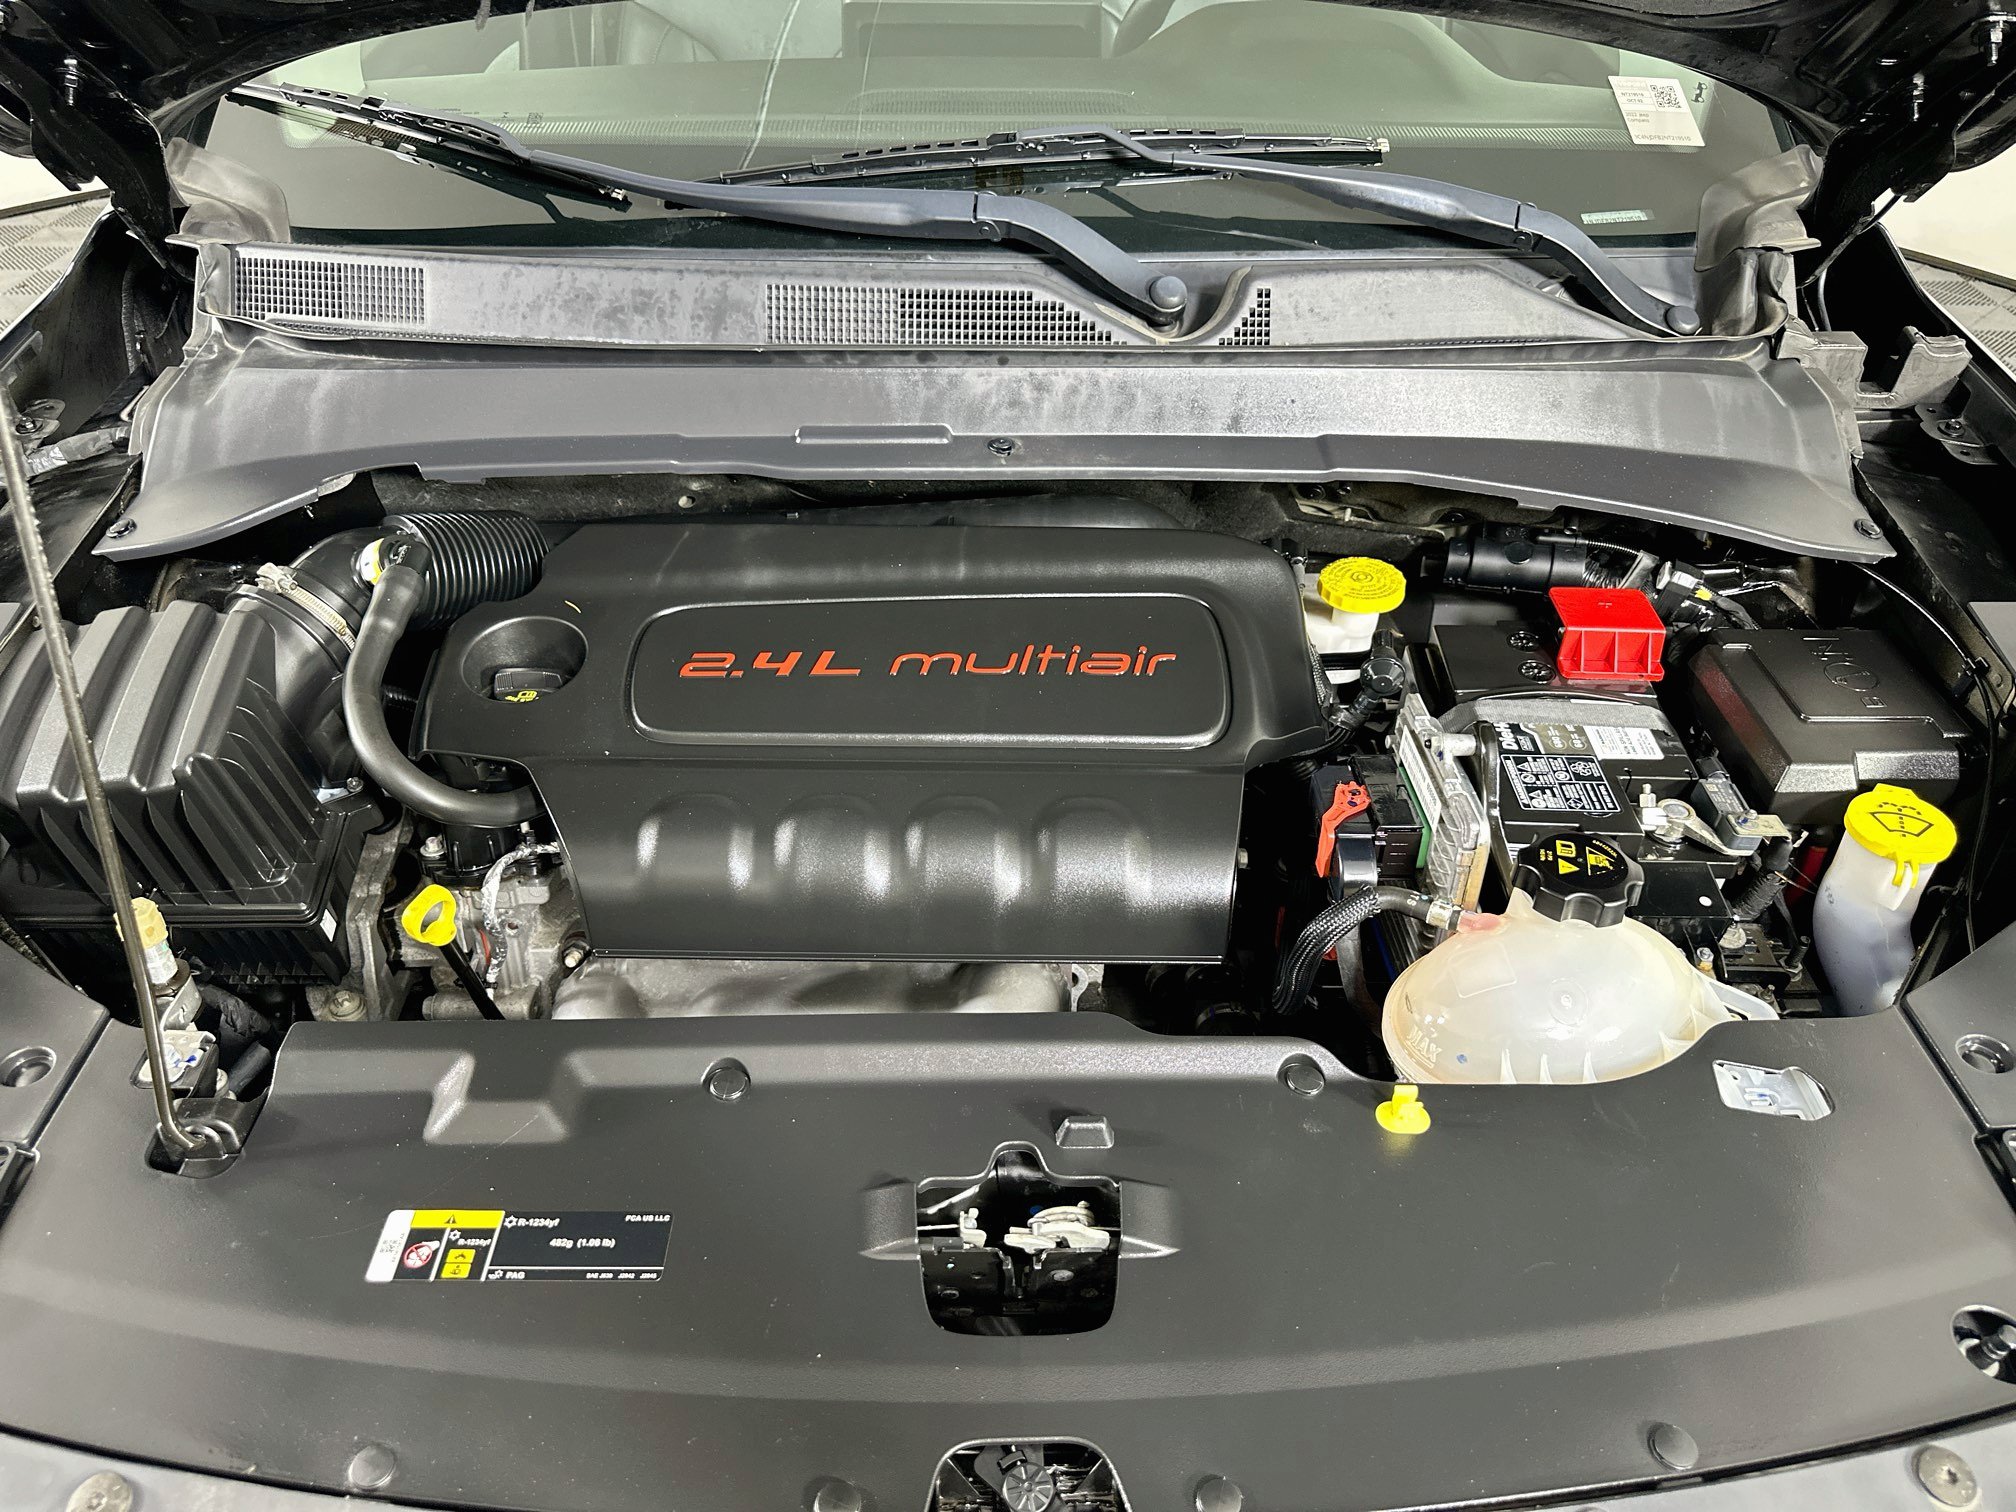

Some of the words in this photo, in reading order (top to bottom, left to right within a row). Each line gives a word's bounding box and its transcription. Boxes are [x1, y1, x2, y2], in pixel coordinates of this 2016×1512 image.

[889, 644, 1178, 677] multiair
[1493, 722, 1519, 751] DieH
[517, 1217, 561, 1229] R-1234yf
[625, 1214, 642, 1222] FCA
[642, 1214, 654, 1222] US
[654, 1214, 671, 1222] LLC
[549, 1238, 574, 1249] 482g
[601, 1238, 616, 1248] lb)
[505, 1271, 526, 1279] PAG
